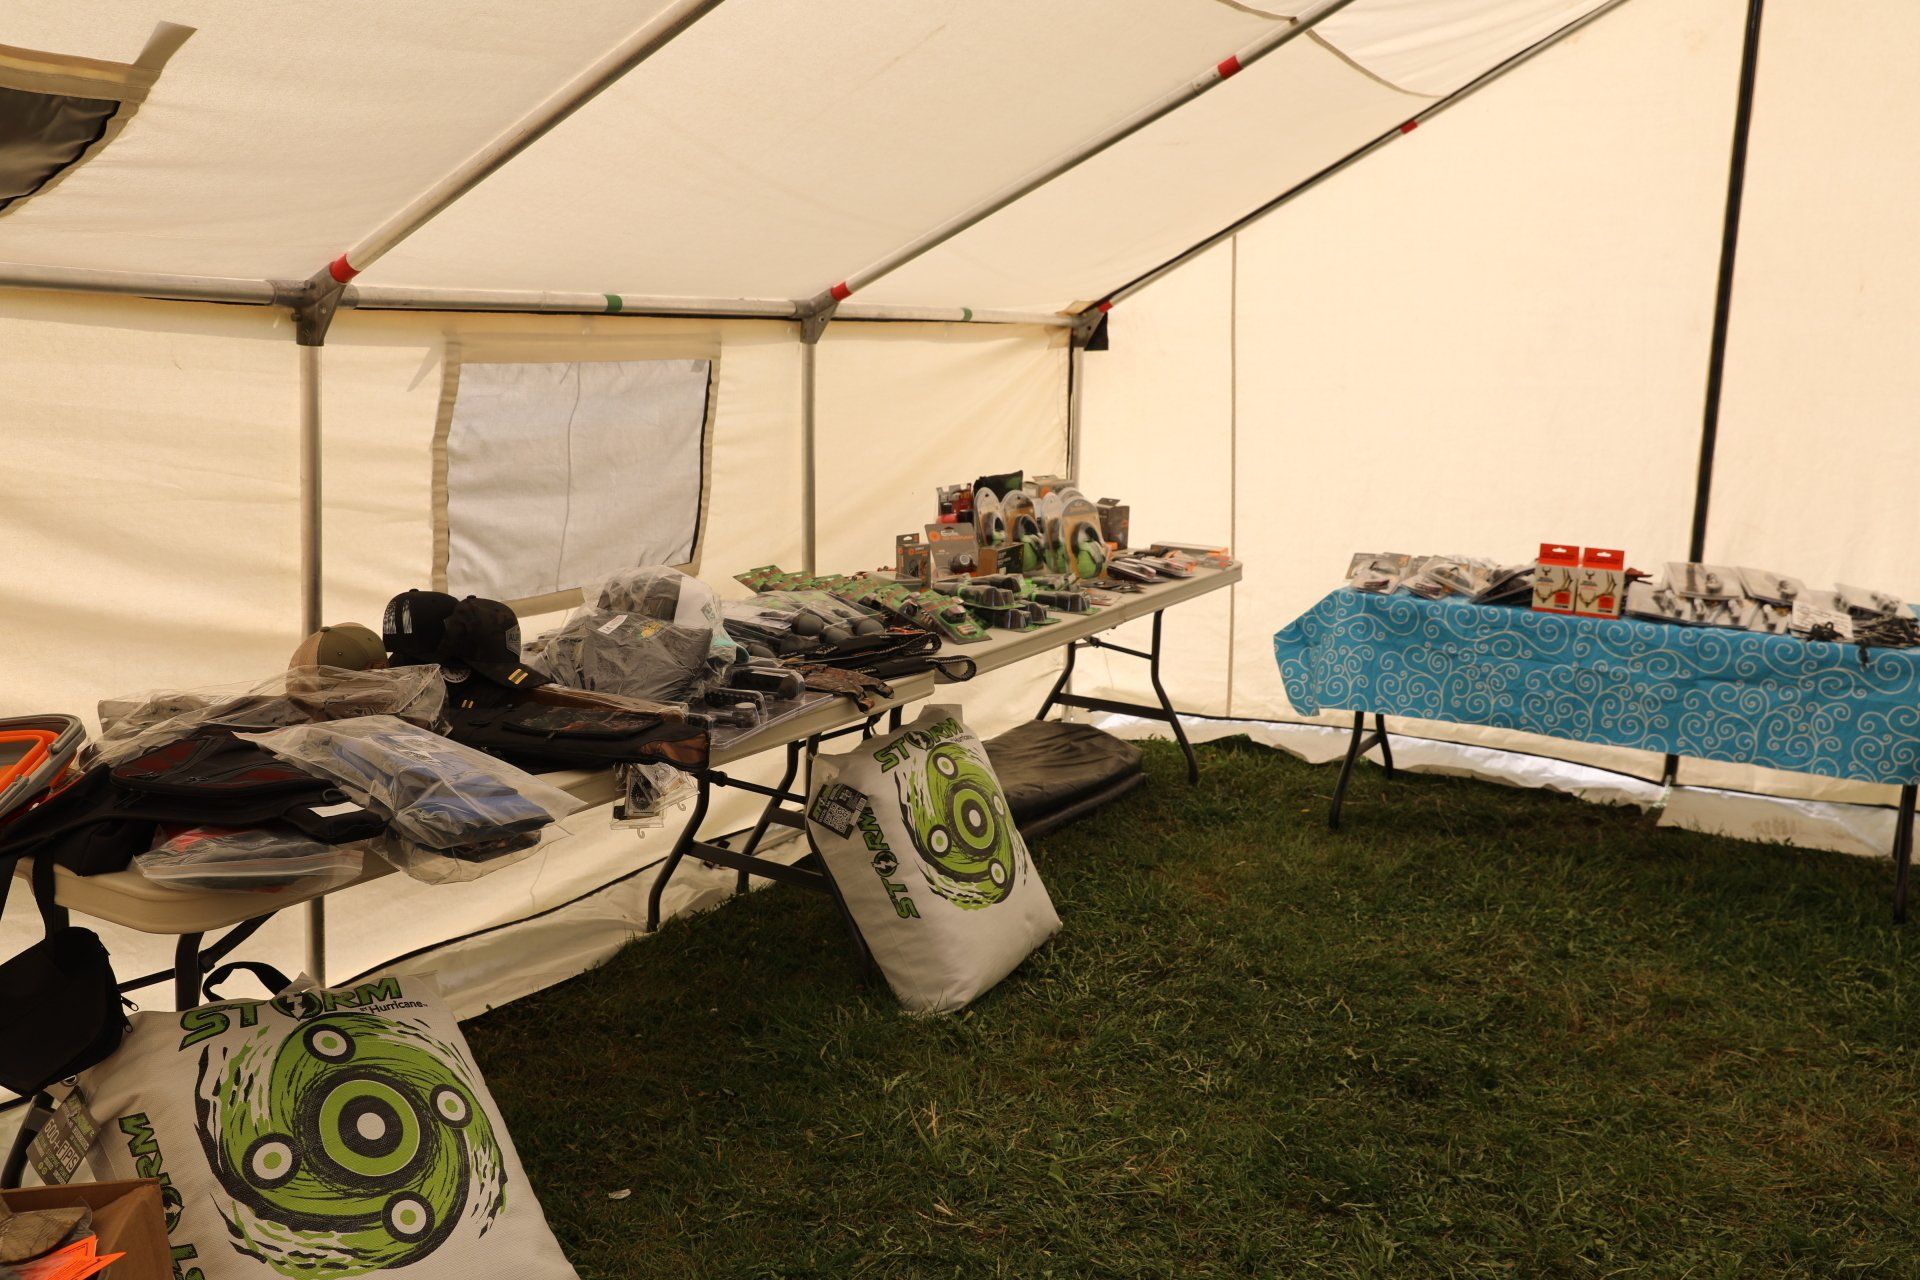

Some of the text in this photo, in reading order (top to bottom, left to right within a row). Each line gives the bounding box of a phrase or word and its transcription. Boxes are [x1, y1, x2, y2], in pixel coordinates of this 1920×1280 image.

[873, 717, 964, 773] STORM
[857, 807, 920, 919] STORM
[178, 977, 403, 1052] STORM
[369, 1000, 424, 1014] Hurricane
